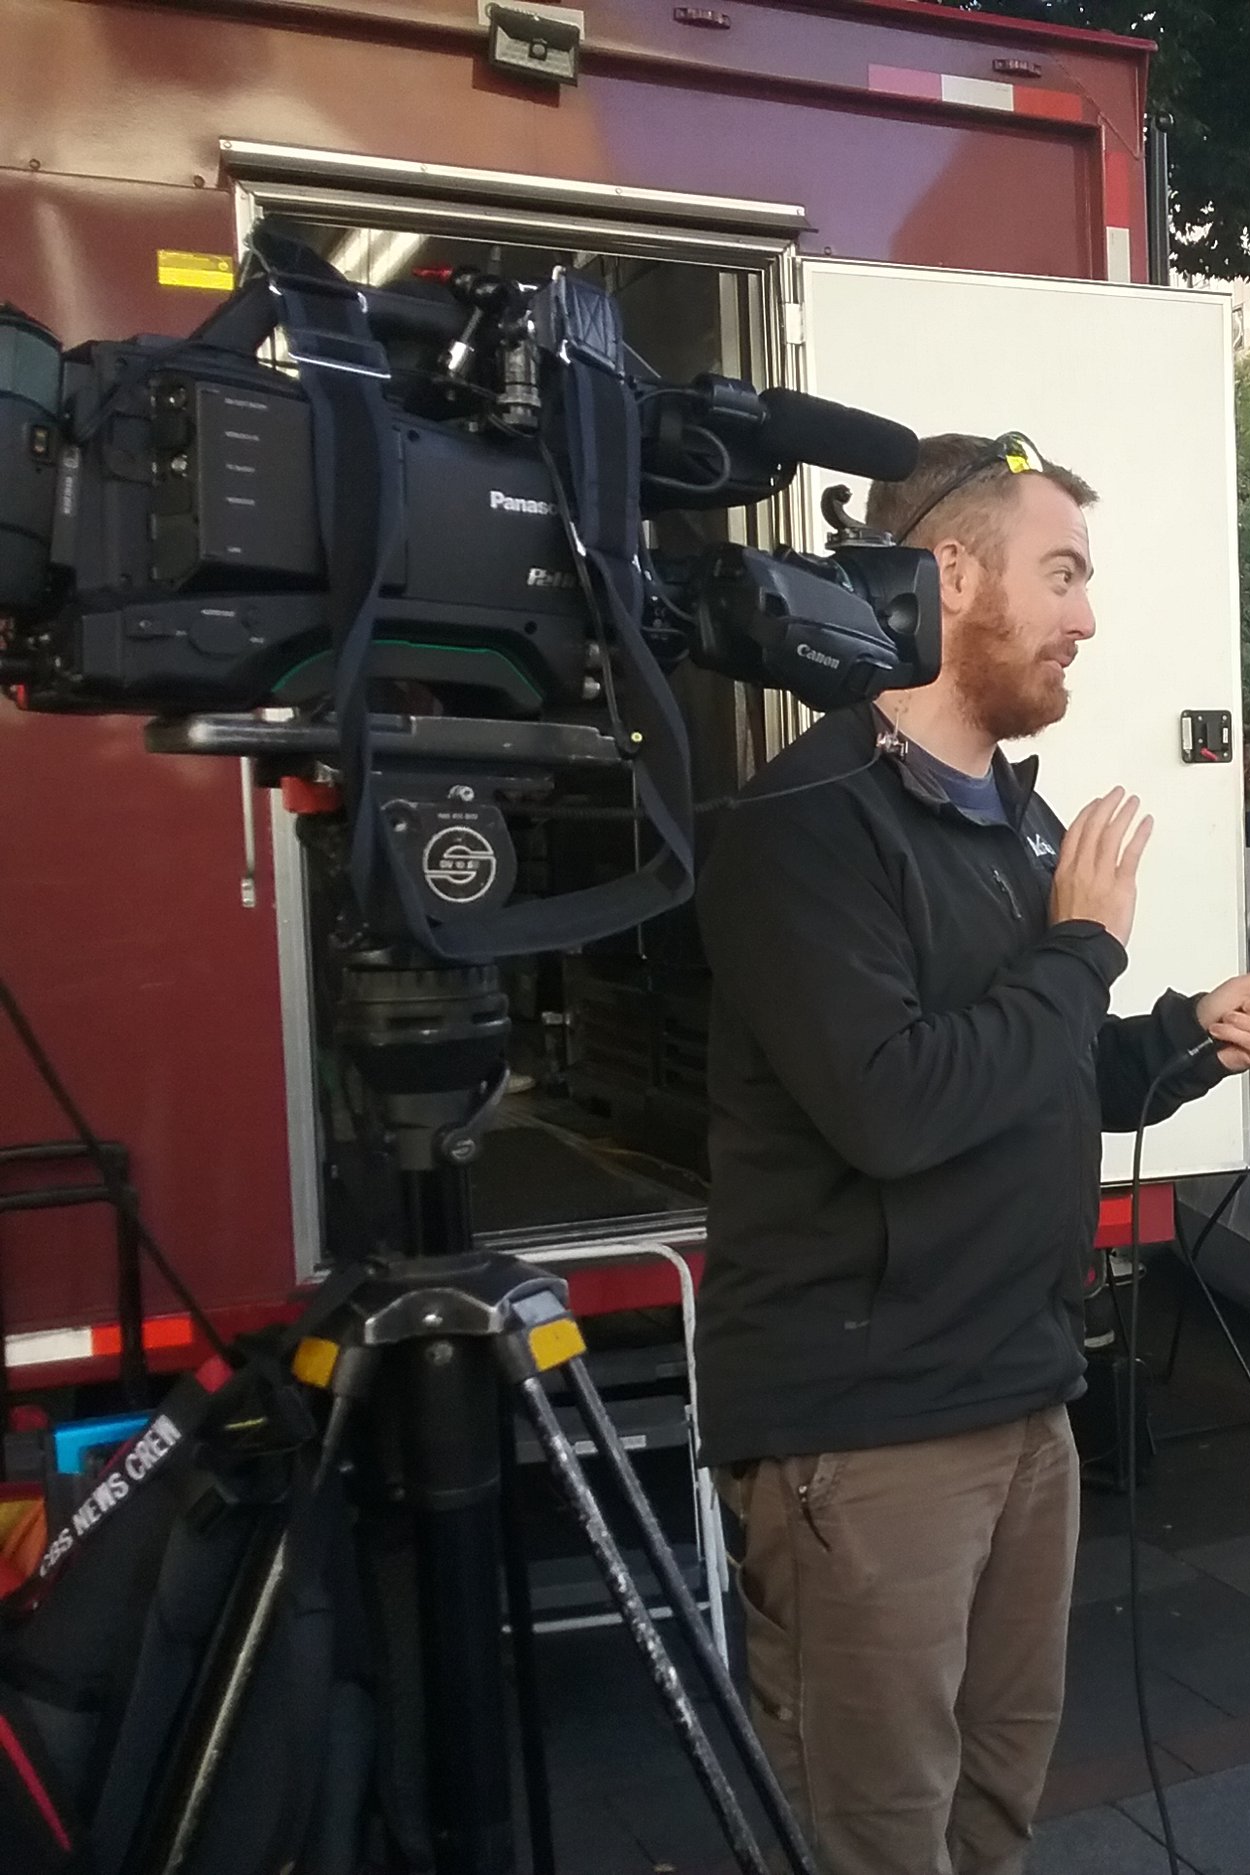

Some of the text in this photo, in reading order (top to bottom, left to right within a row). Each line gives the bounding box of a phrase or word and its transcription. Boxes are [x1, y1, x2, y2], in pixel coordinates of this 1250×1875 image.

[797, 643, 840, 669] Canon
[40, 1528, 73, 1578] CBS
[72, 1472, 129, 1536] NEWS
